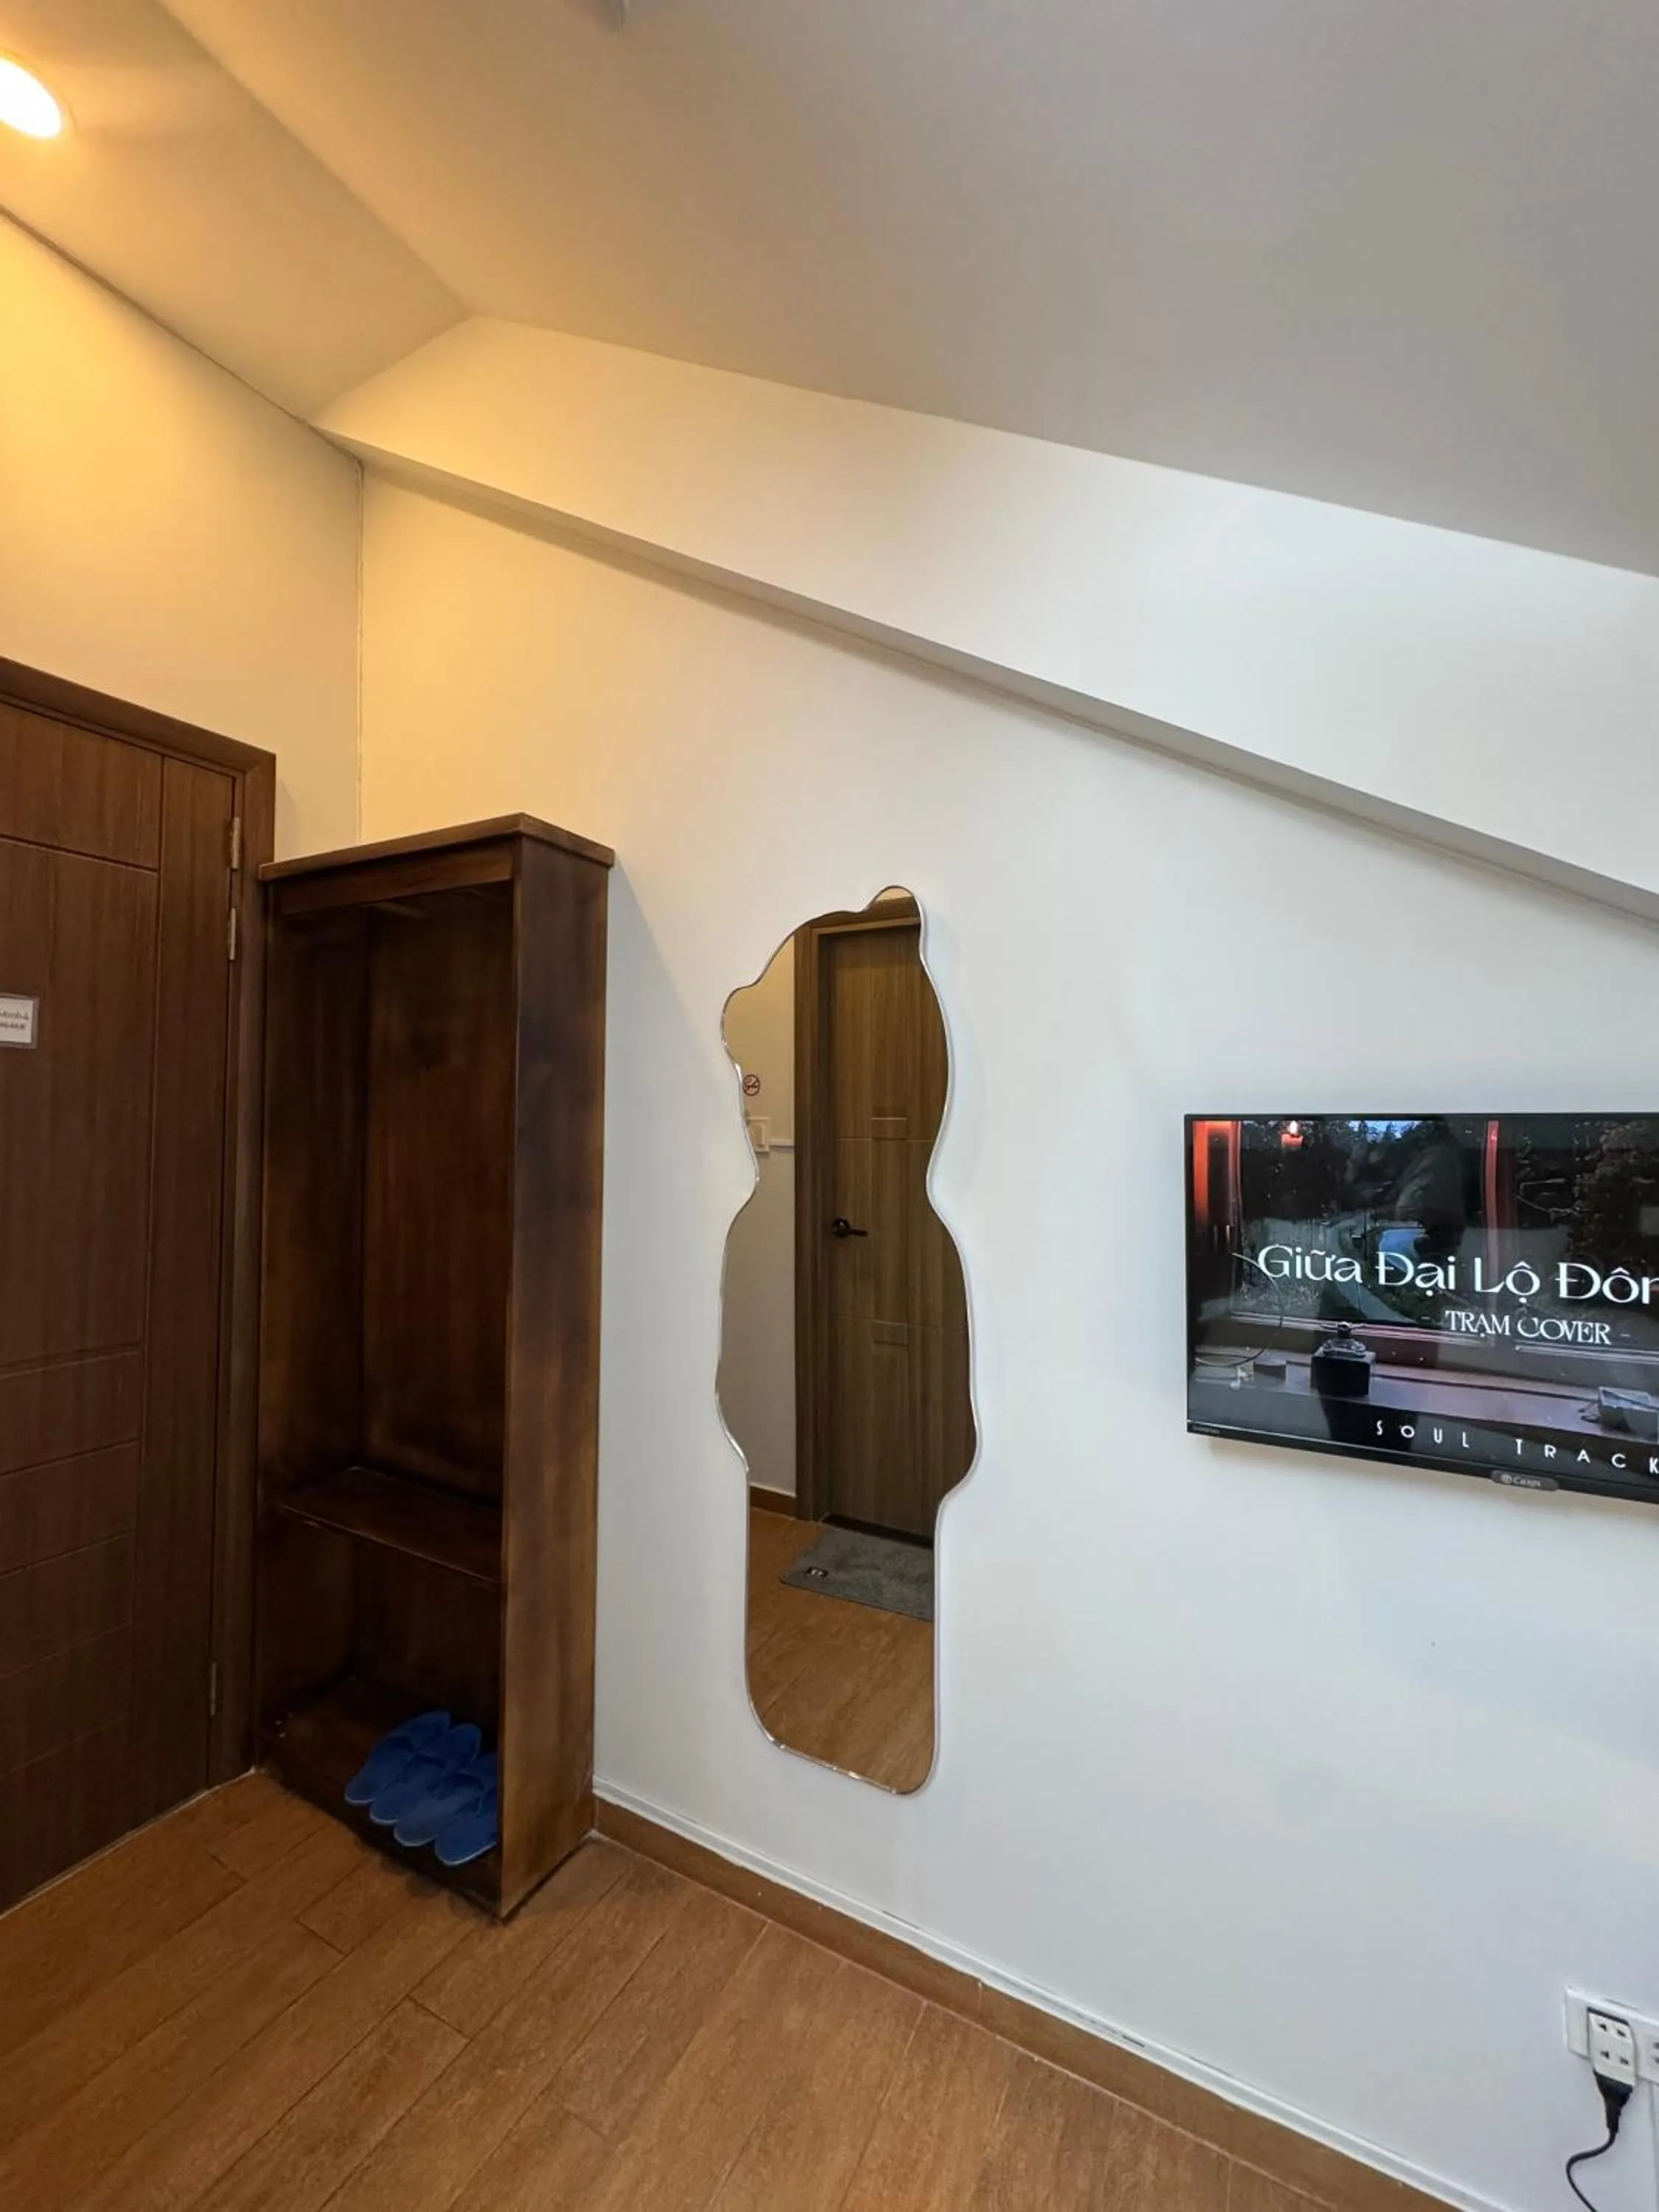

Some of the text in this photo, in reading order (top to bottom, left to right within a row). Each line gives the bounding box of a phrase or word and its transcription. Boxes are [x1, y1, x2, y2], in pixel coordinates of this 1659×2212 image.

[1257, 1244, 1363, 1284] Giữa
[1375, 1251, 1457, 1297] Đại
[1474, 1257, 1540, 1304] Lộ
[1444, 1310, 1612, 1346] TRẠM COVER
[1376, 1420, 1659, 1475] SOUL TRACK
